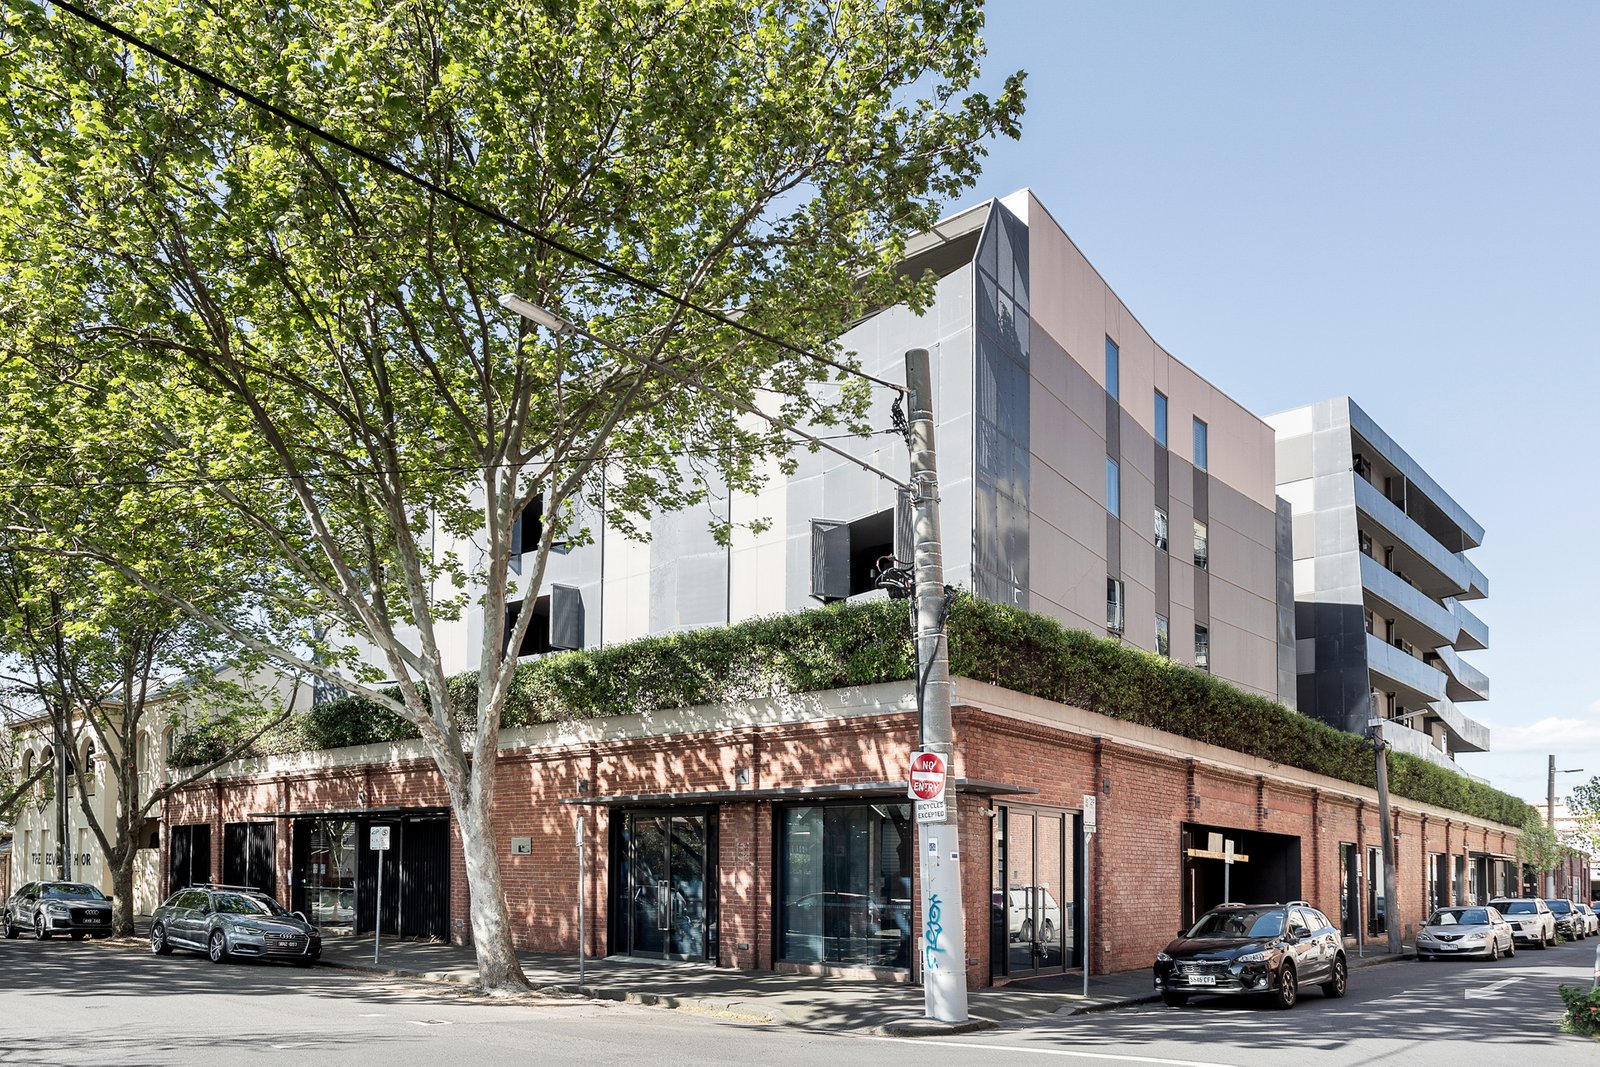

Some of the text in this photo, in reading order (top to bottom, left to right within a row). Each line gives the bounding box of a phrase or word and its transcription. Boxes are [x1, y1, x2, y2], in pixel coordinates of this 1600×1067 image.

[922, 760, 934, 770] NO
[913, 782, 940, 793] ENTRY
[917, 802, 944, 810] BICYCLES
[917, 811, 945, 819] EXCEPTED
